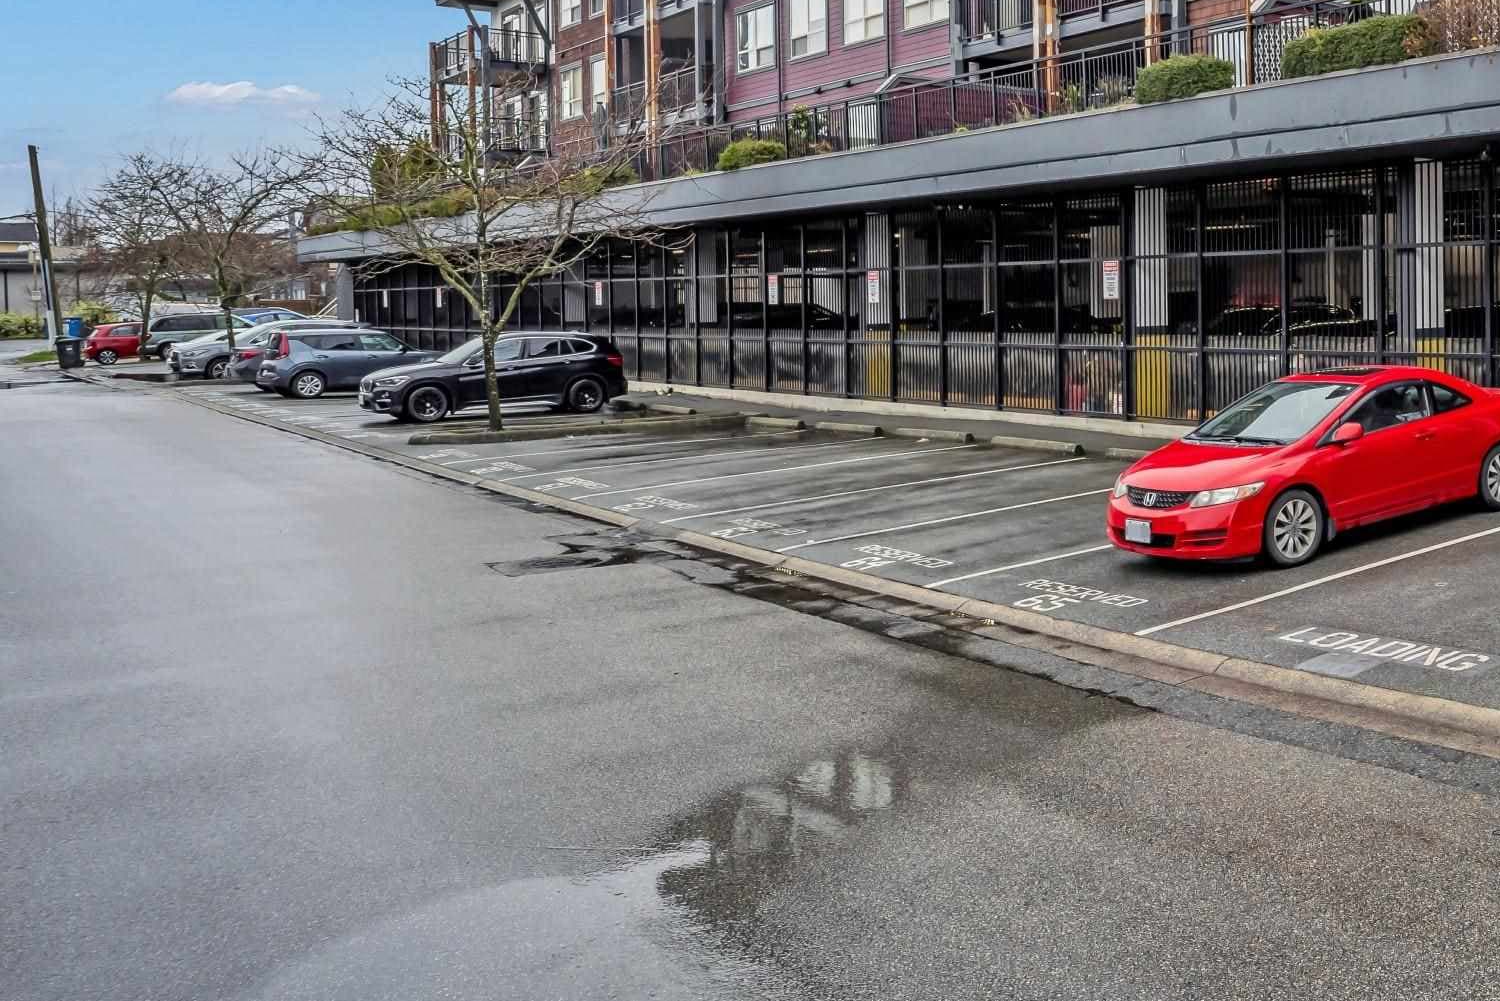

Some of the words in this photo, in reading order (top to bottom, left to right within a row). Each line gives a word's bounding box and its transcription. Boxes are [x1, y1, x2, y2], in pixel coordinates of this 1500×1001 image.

[840, 557, 896, 570] 64
[854, 545, 955, 568] RESERVED
[1013, 594, 1081, 611] 65
[1017, 579, 1149, 607] RESERVED
[1279, 626, 1490, 671] LOADING
